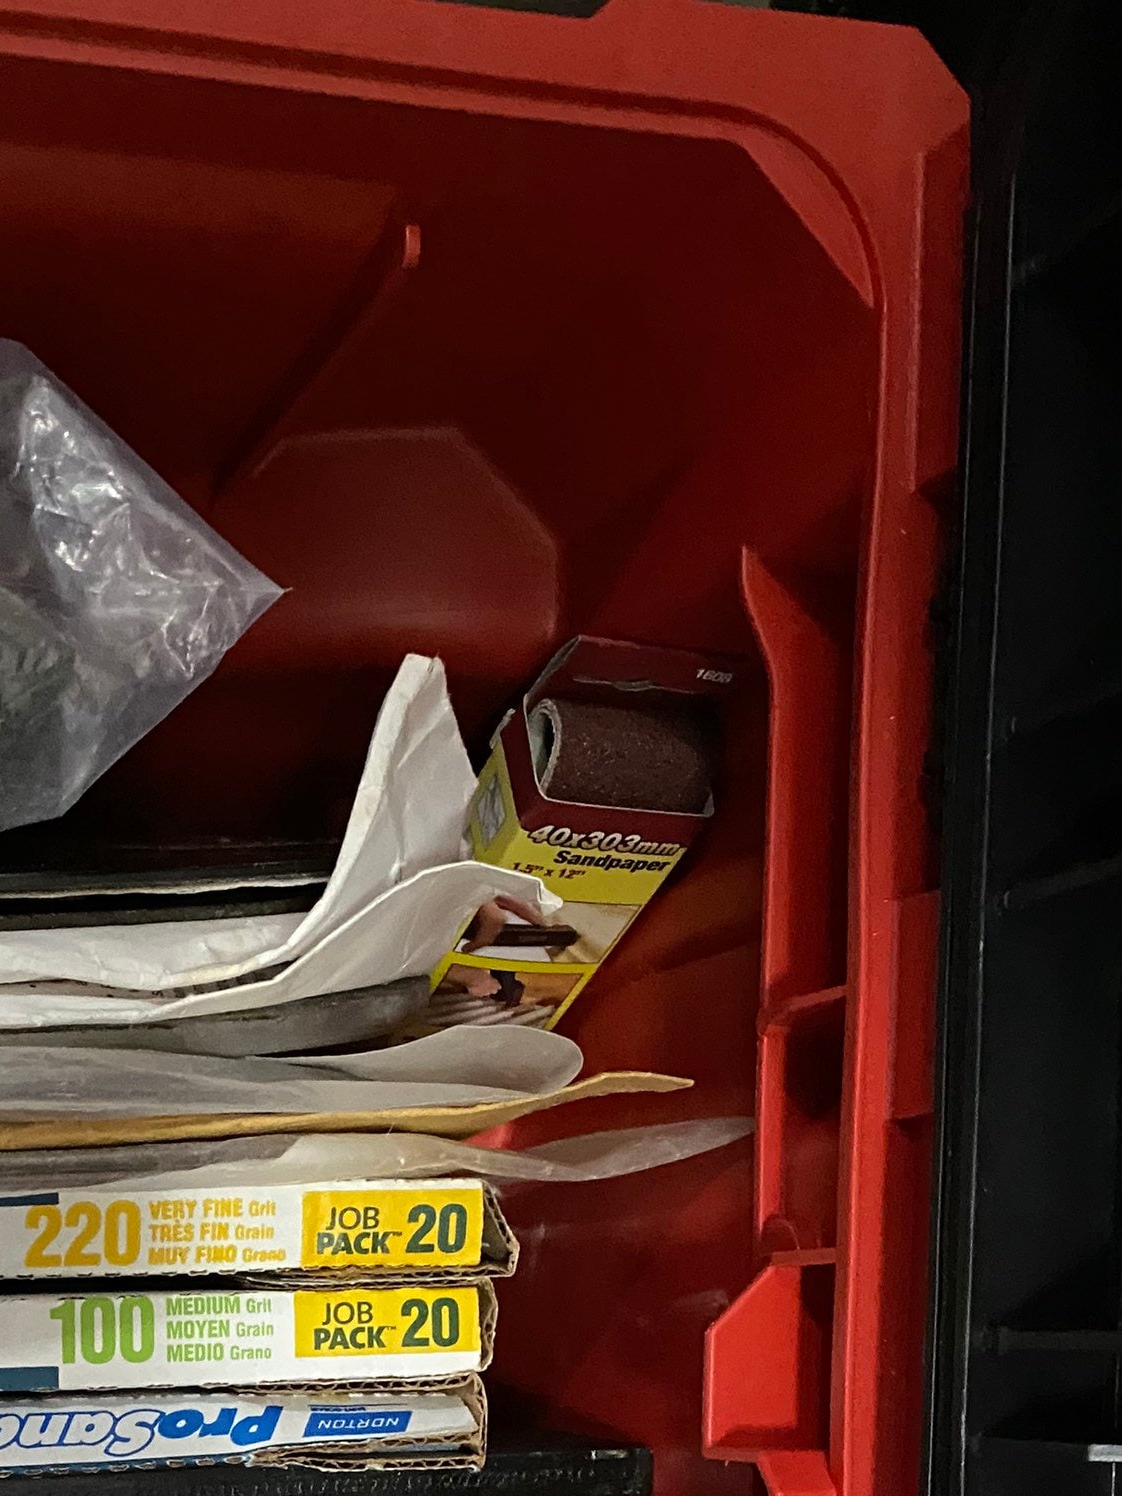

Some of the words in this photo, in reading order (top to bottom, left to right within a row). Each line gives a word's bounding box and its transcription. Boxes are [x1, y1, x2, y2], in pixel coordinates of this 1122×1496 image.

[528, 825, 681, 857] 40x303mm
[553, 850, 671, 873] Sandpaper
[148, 1200, 197, 1220] VERY
[203, 1198, 243, 1217] FINE
[249, 1200, 276, 1216] Grit
[325, 1206, 380, 1230] JOB
[24, 1199, 141, 1268] 220
[149, 1219, 194, 1242] TRÈS
[199, 1222, 229, 1241] FIN
[235, 1224, 275, 1240] Grain
[405, 1203, 468, 1254] 20
[148, 1246, 191, 1265] MUY
[195, 1244, 237, 1264] FINO
[242, 1247, 287, 1263] Grano
[166, 1296, 240, 1316] MEDIUM
[246, 1298, 272, 1313] Grit
[322, 1302, 373, 1325] JOB
[49, 1295, 155, 1364] 100
[167, 1320, 230, 1339] MOYEN
[236, 1322, 274, 1337] Grain
[400, 1297, 460, 1347] 20
[167, 1343, 224, 1362] MEDIO
[230, 1346, 272, 1360] Grano
[318, 1416, 400, 1429] NORTON
